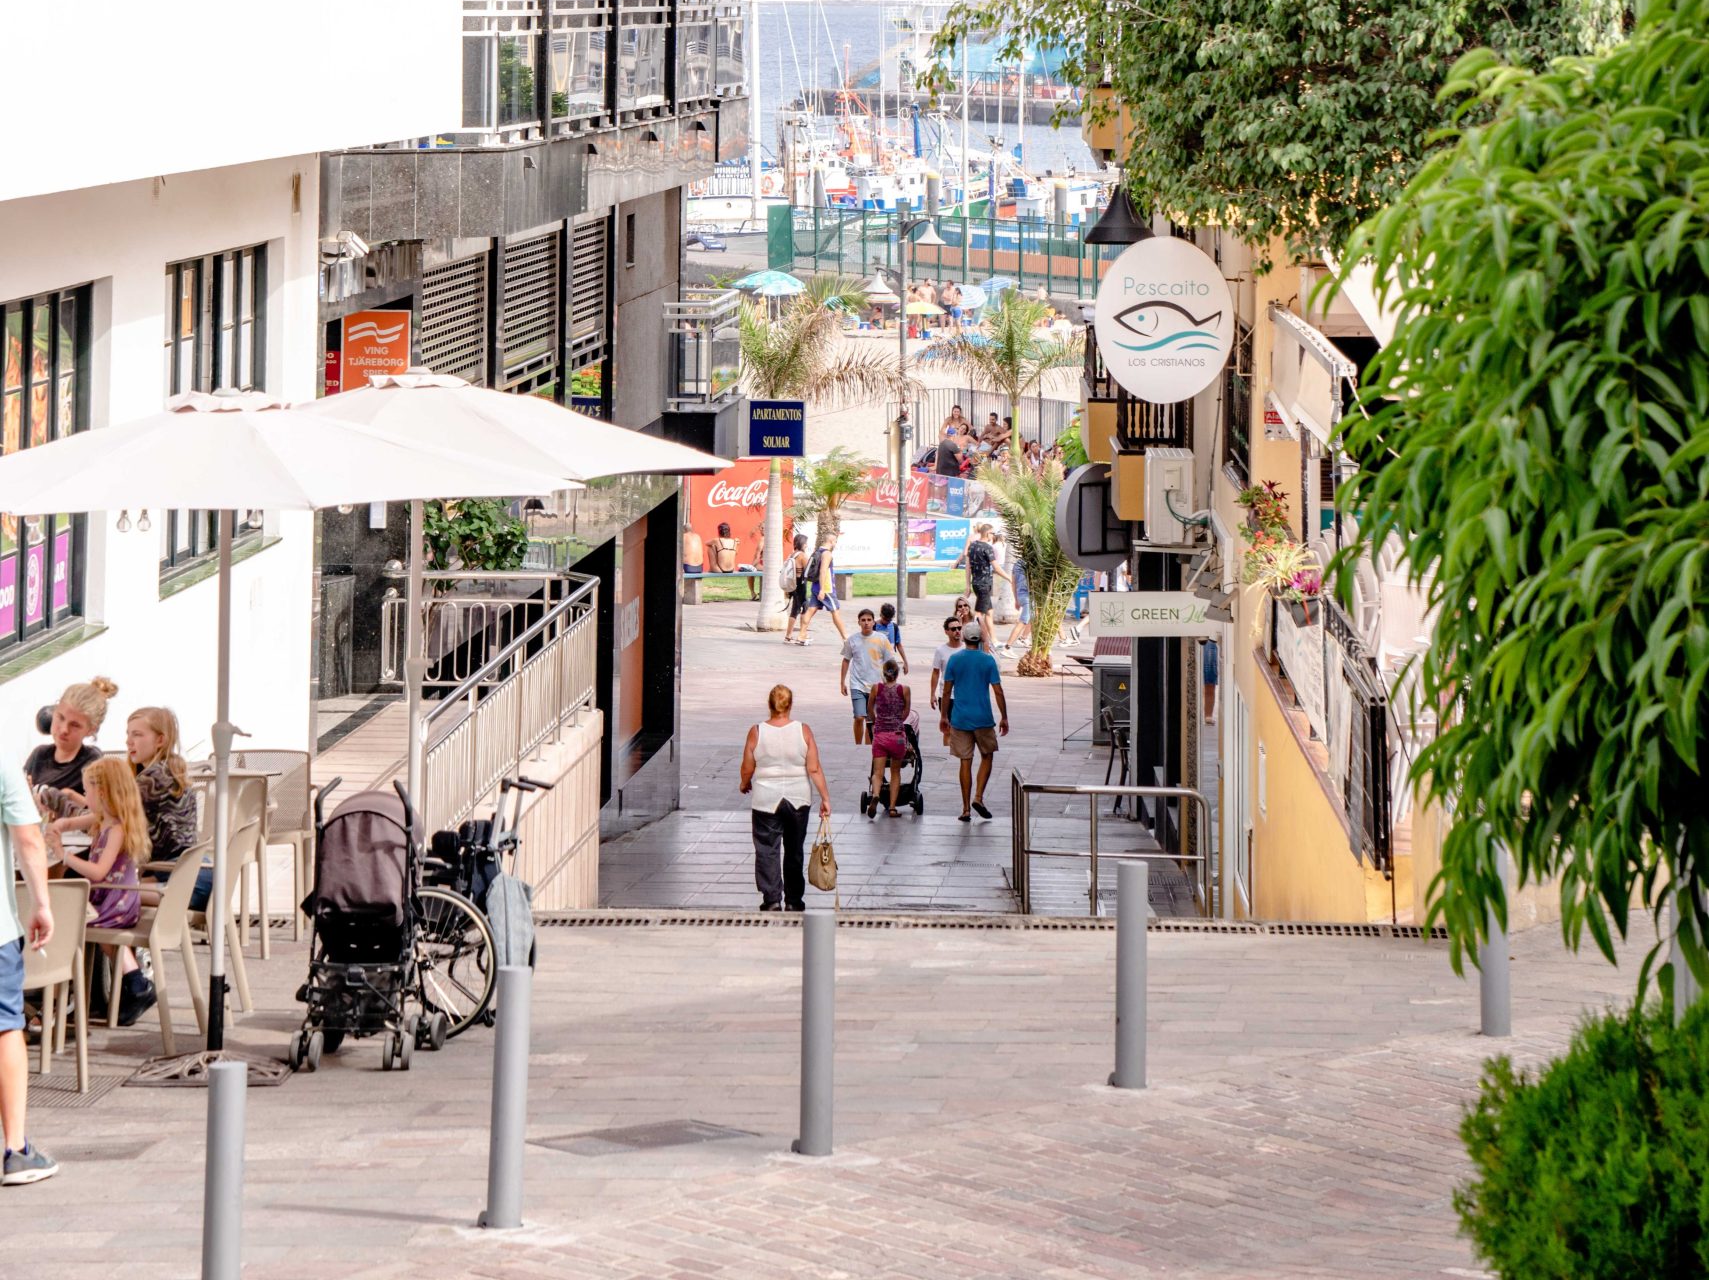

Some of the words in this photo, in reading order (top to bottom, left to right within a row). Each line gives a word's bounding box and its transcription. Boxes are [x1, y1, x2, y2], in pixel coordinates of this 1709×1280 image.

[1123, 277, 1210, 296] Pescaito
[364, 346, 389, 355] VING
[348, 356, 404, 366] TJÄREBORG
[1128, 358, 1147, 367] LOS
[1150, 358, 1206, 367] CRISTIANOS
[752, 408, 802, 421] APARTAMENTOS
[763, 436, 791, 448] SOLMAR
[707, 480, 769, 508] Coca-Col
[1130, 608, 1180, 621] GREEN
